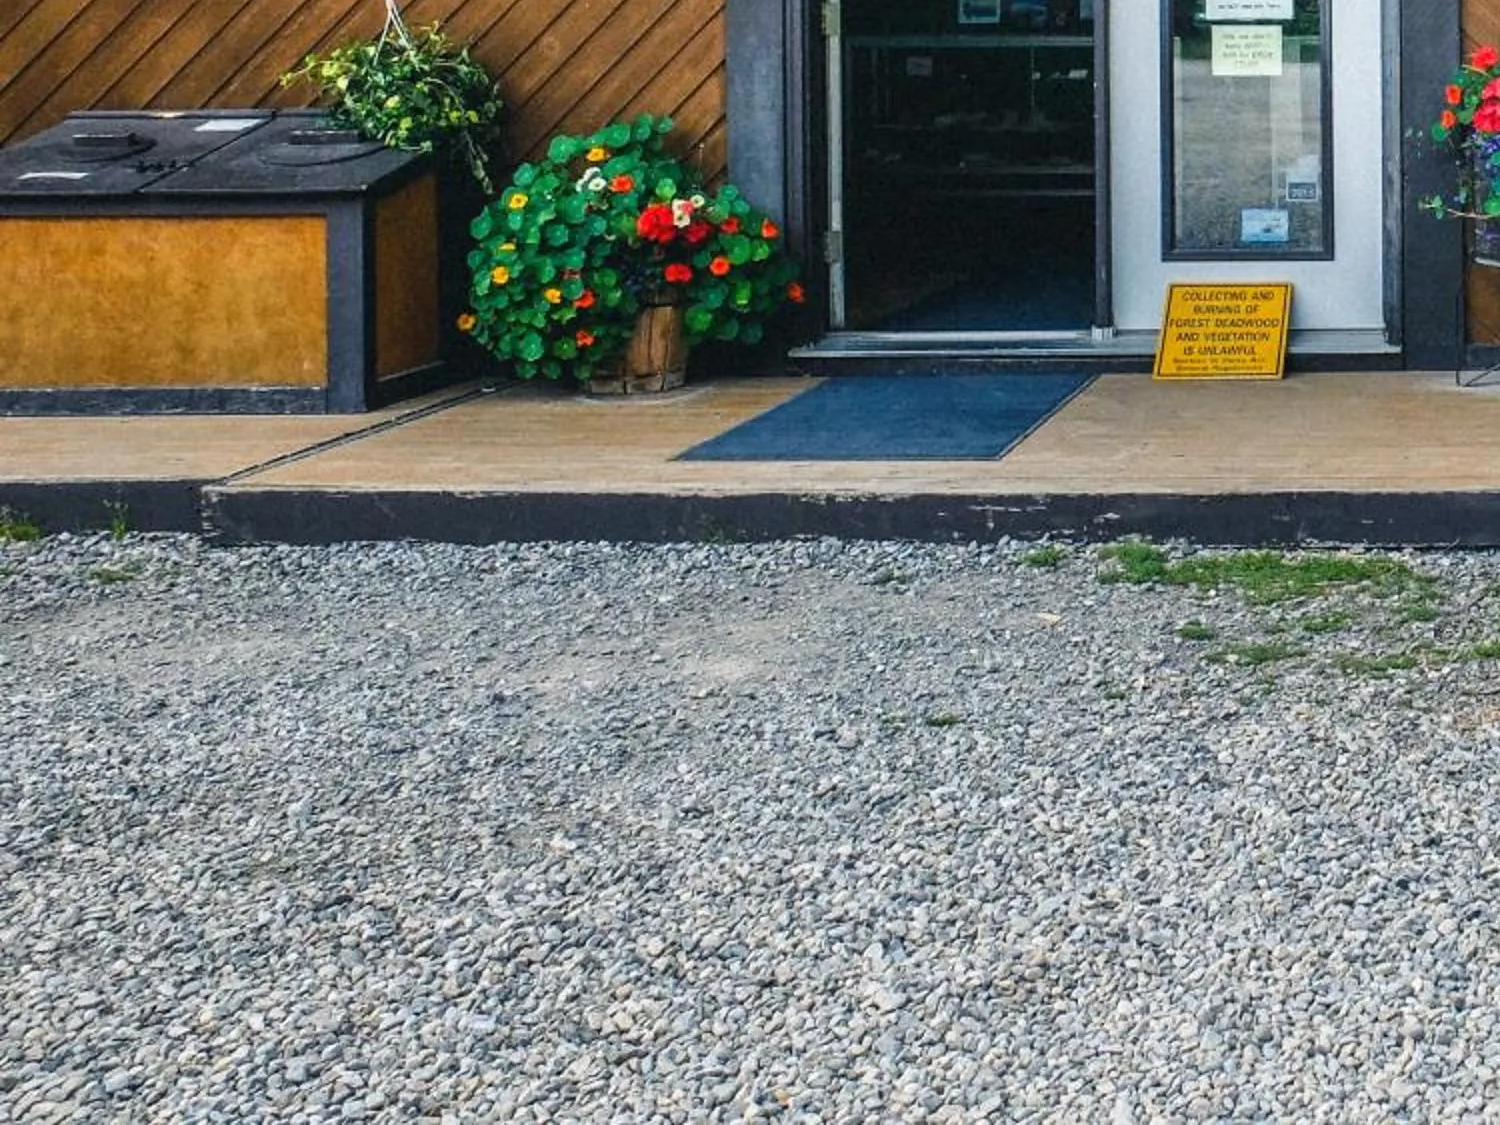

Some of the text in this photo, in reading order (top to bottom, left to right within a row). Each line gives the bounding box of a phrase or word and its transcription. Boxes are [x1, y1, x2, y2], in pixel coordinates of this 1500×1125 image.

[1182, 290, 1275, 302] COLLECTING AND
[1193, 304, 1261, 315] BURNING OF
[1169, 318, 1280, 328] FOREST DEADWOOD
[1175, 332, 1271, 342] AND VEGETATION
[1183, 346, 1257, 356] IS UNLAWFUL
